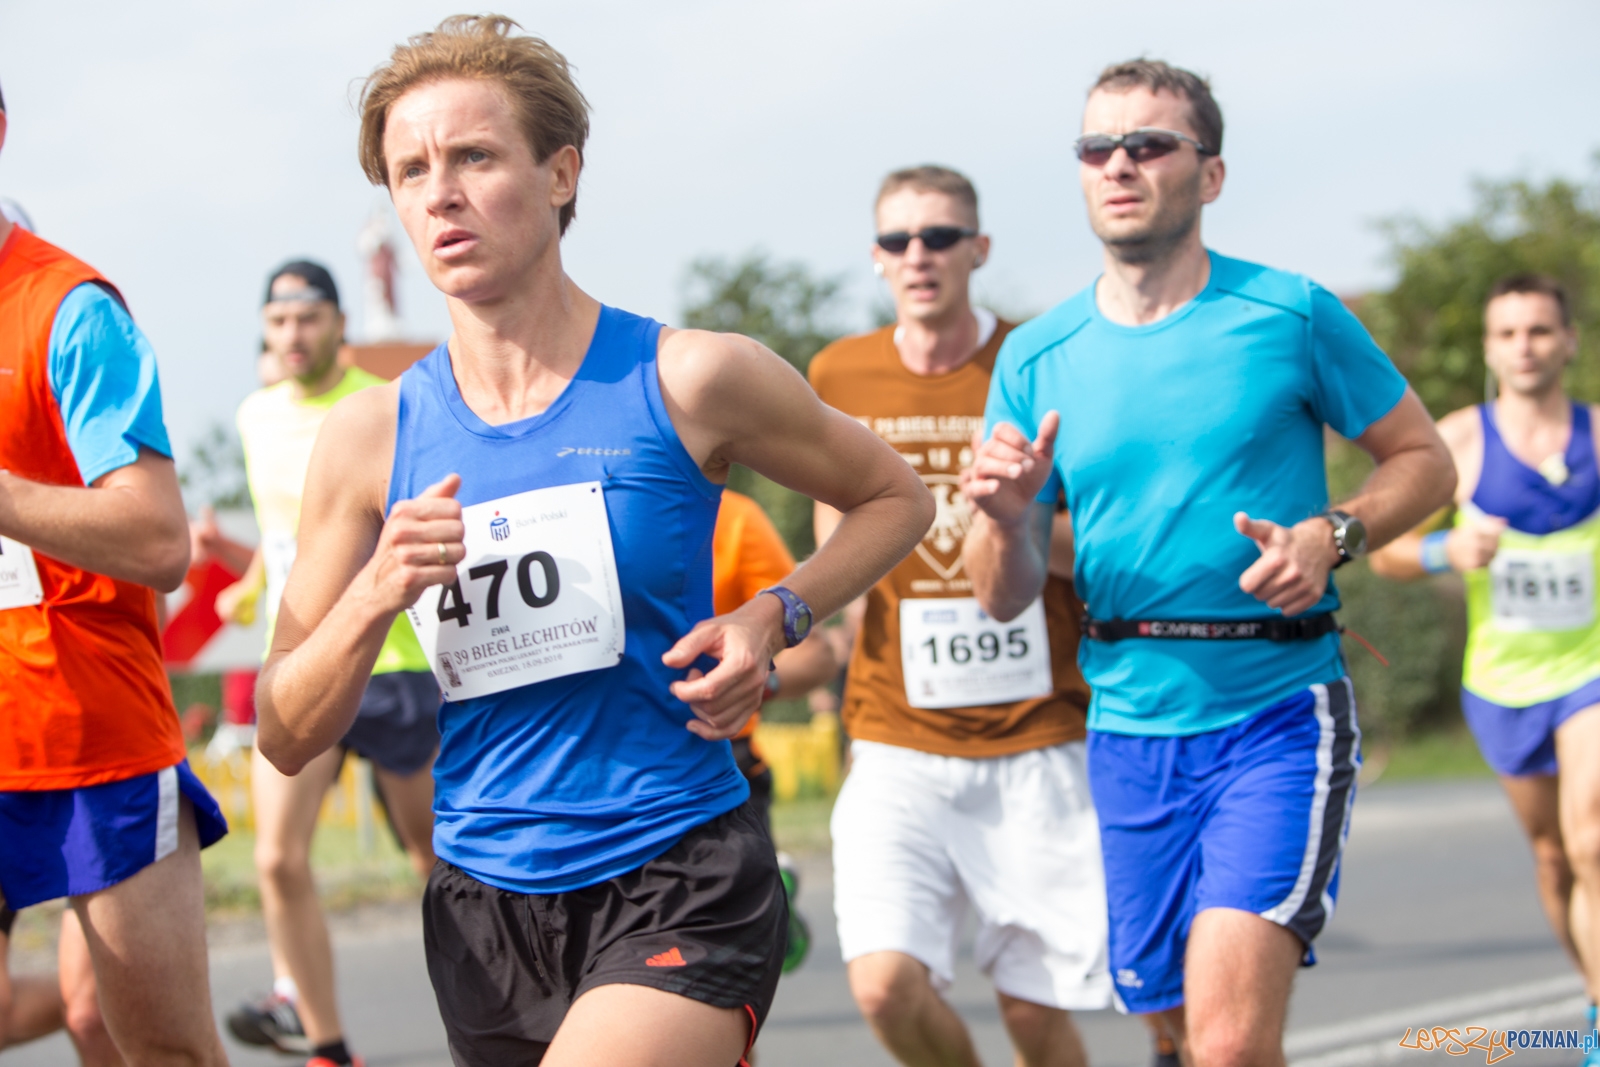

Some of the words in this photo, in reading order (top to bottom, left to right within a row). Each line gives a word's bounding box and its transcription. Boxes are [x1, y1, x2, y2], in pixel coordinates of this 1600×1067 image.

[436, 550, 560, 629] 470
[471, 639, 509, 661] BIEG
[511, 615, 599, 650] LECHITÓW
[491, 625, 511, 637] EWA
[921, 627, 1030, 665] 1695
